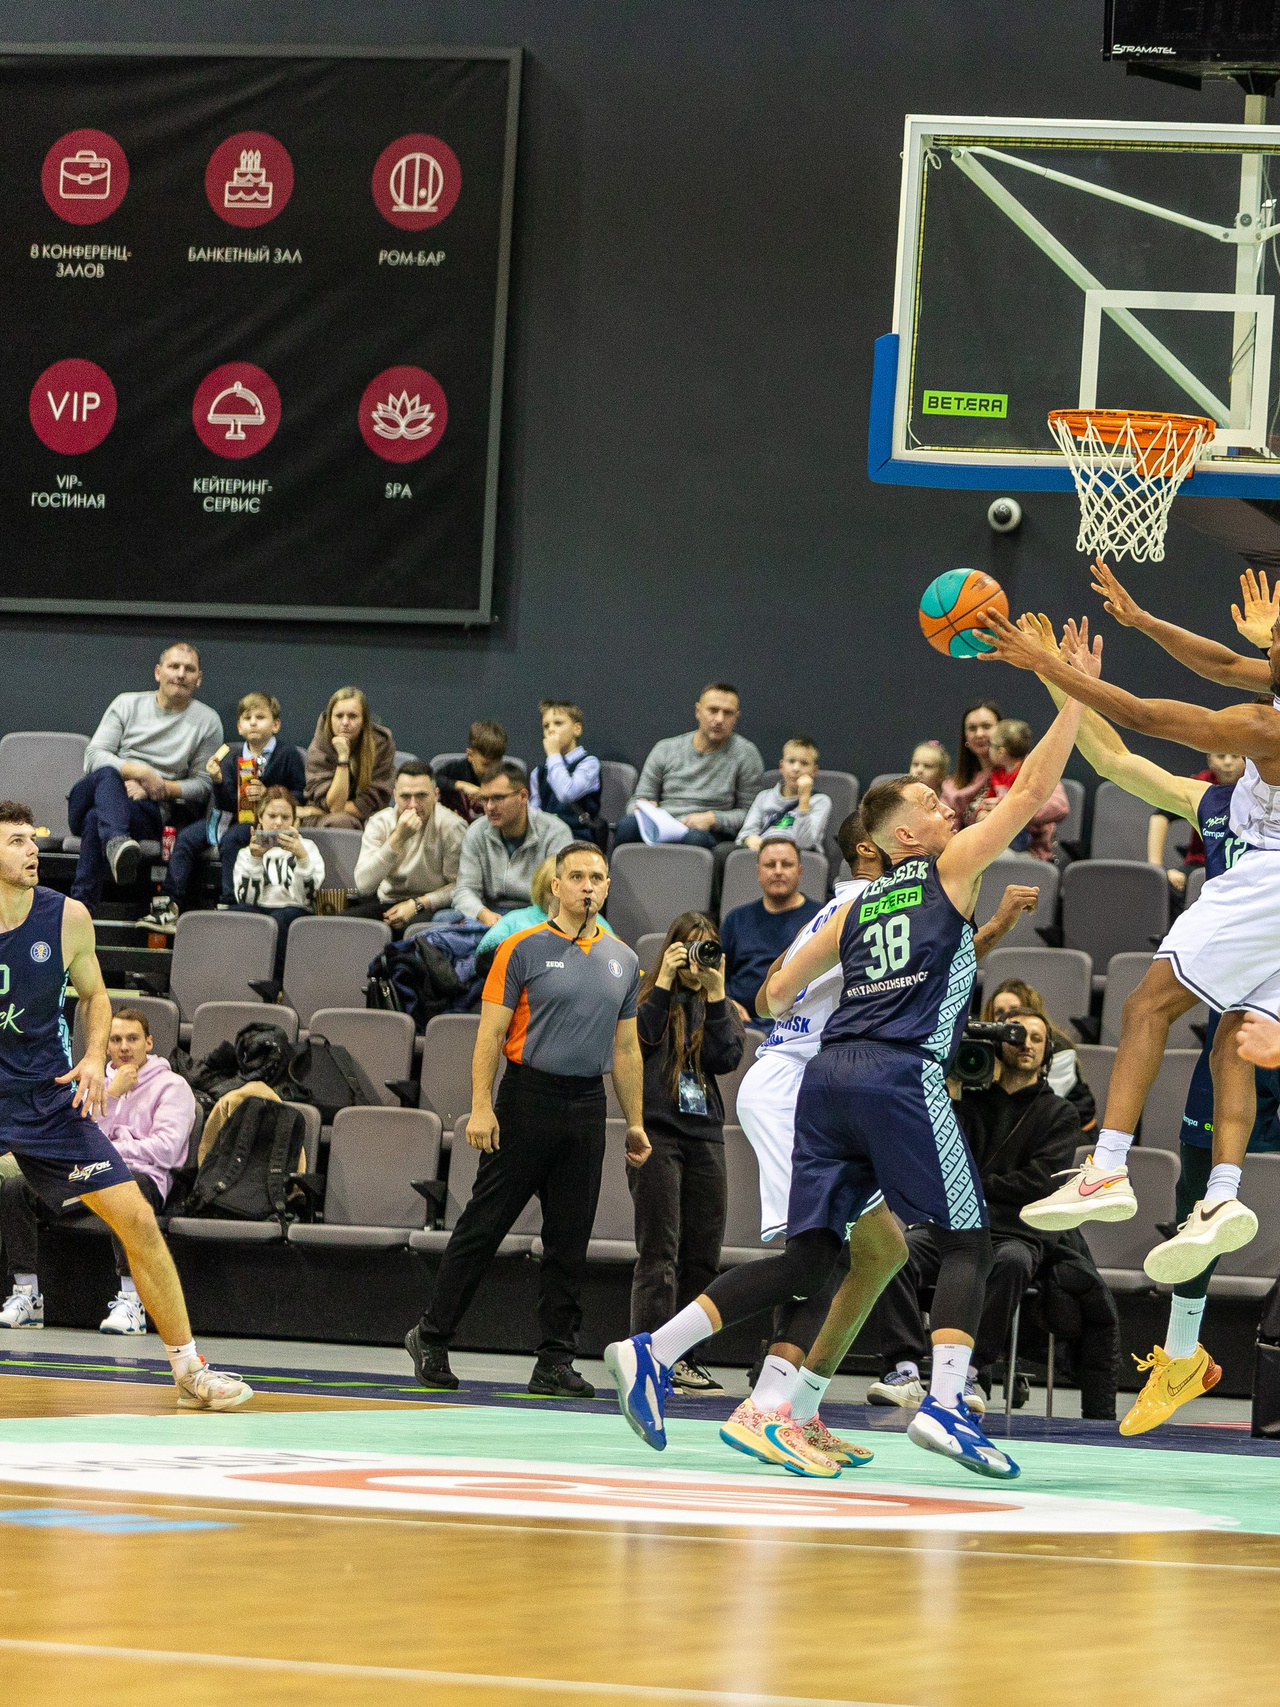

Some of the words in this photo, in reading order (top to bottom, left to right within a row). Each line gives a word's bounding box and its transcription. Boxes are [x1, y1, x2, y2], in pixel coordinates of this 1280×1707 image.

[1112, 44, 1177, 55] STRAMATEL
[30, 243, 40, 259] 8
[42, 243, 133, 261] КОНФЕРЕНЦ-
[188, 245, 270, 263] БАНКЕТНЫЙ
[273, 247, 303, 264] ЗАЛ
[378, 249, 446, 266] РОМ-БАР
[55, 262, 105, 278] ЗАЛОВ
[47, 391, 101, 422] VIP
[56, 474, 83, 490] VIP-
[193, 475, 273, 495] КЕЙТЕРИНГ-
[385, 482, 413, 499] SPA
[31, 492, 106, 509] ГОСТИНАЯ
[203, 496, 261, 514] СЕРВИС
[863, 914, 910, 981] 38
